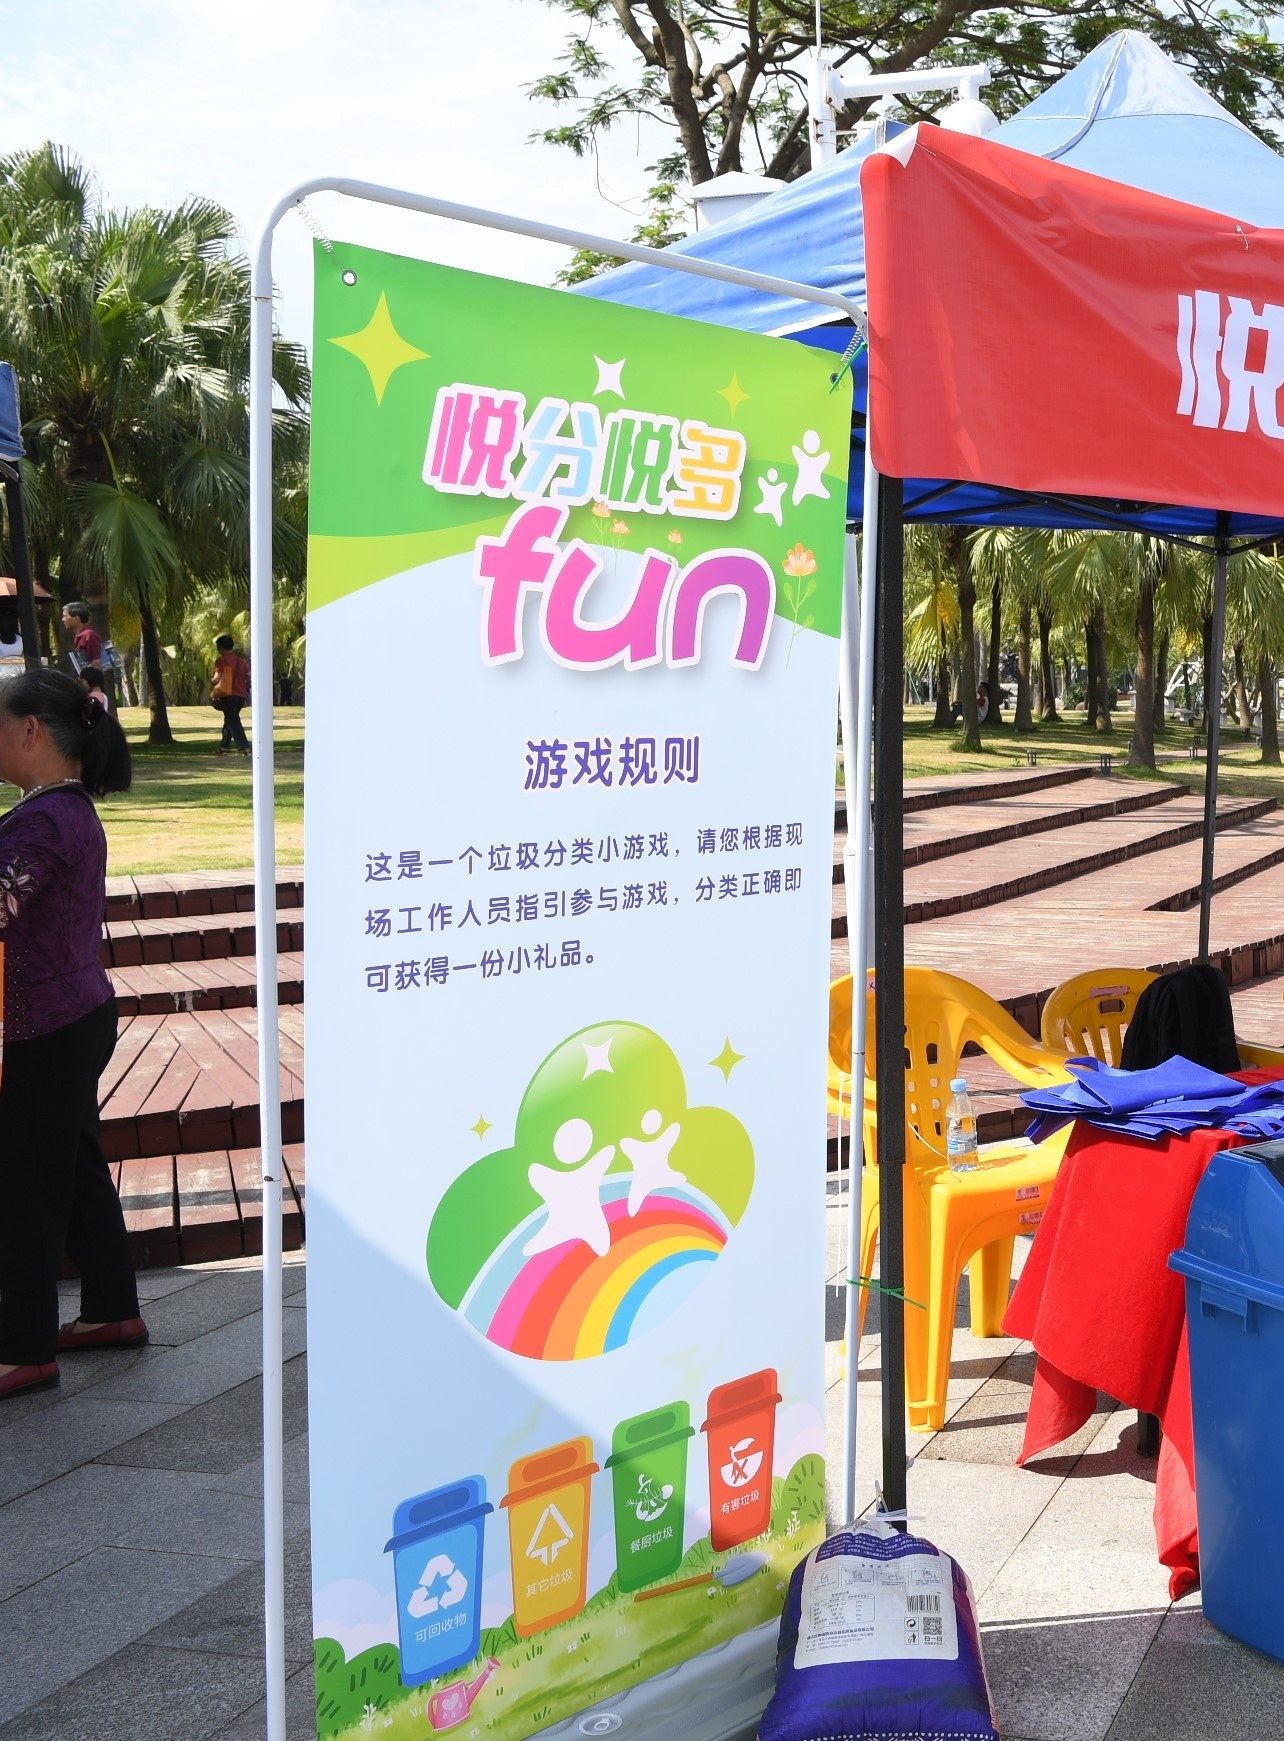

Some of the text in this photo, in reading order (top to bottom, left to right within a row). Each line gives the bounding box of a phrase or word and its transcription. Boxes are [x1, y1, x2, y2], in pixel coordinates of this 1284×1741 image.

[426, 387, 744, 516] 悦分悦多
[476, 503, 773, 667] fun
[523, 736, 701, 790] 游戏规则
[364, 822, 804, 883] 这是一个垃圾分类小游戏，请您根据现
[364, 867, 803, 938] 场工作人员指引参与游戏，分类正确即
[364, 940, 596, 993] 可获得一份小礼品。
[720, 1489, 760, 1515] 有害垃圾
[630, 1525, 673, 1554] 餐厨垃圾
[525, 1568, 573, 1599] 其它垃圾
[415, 1612, 467, 1643] 可回收物
